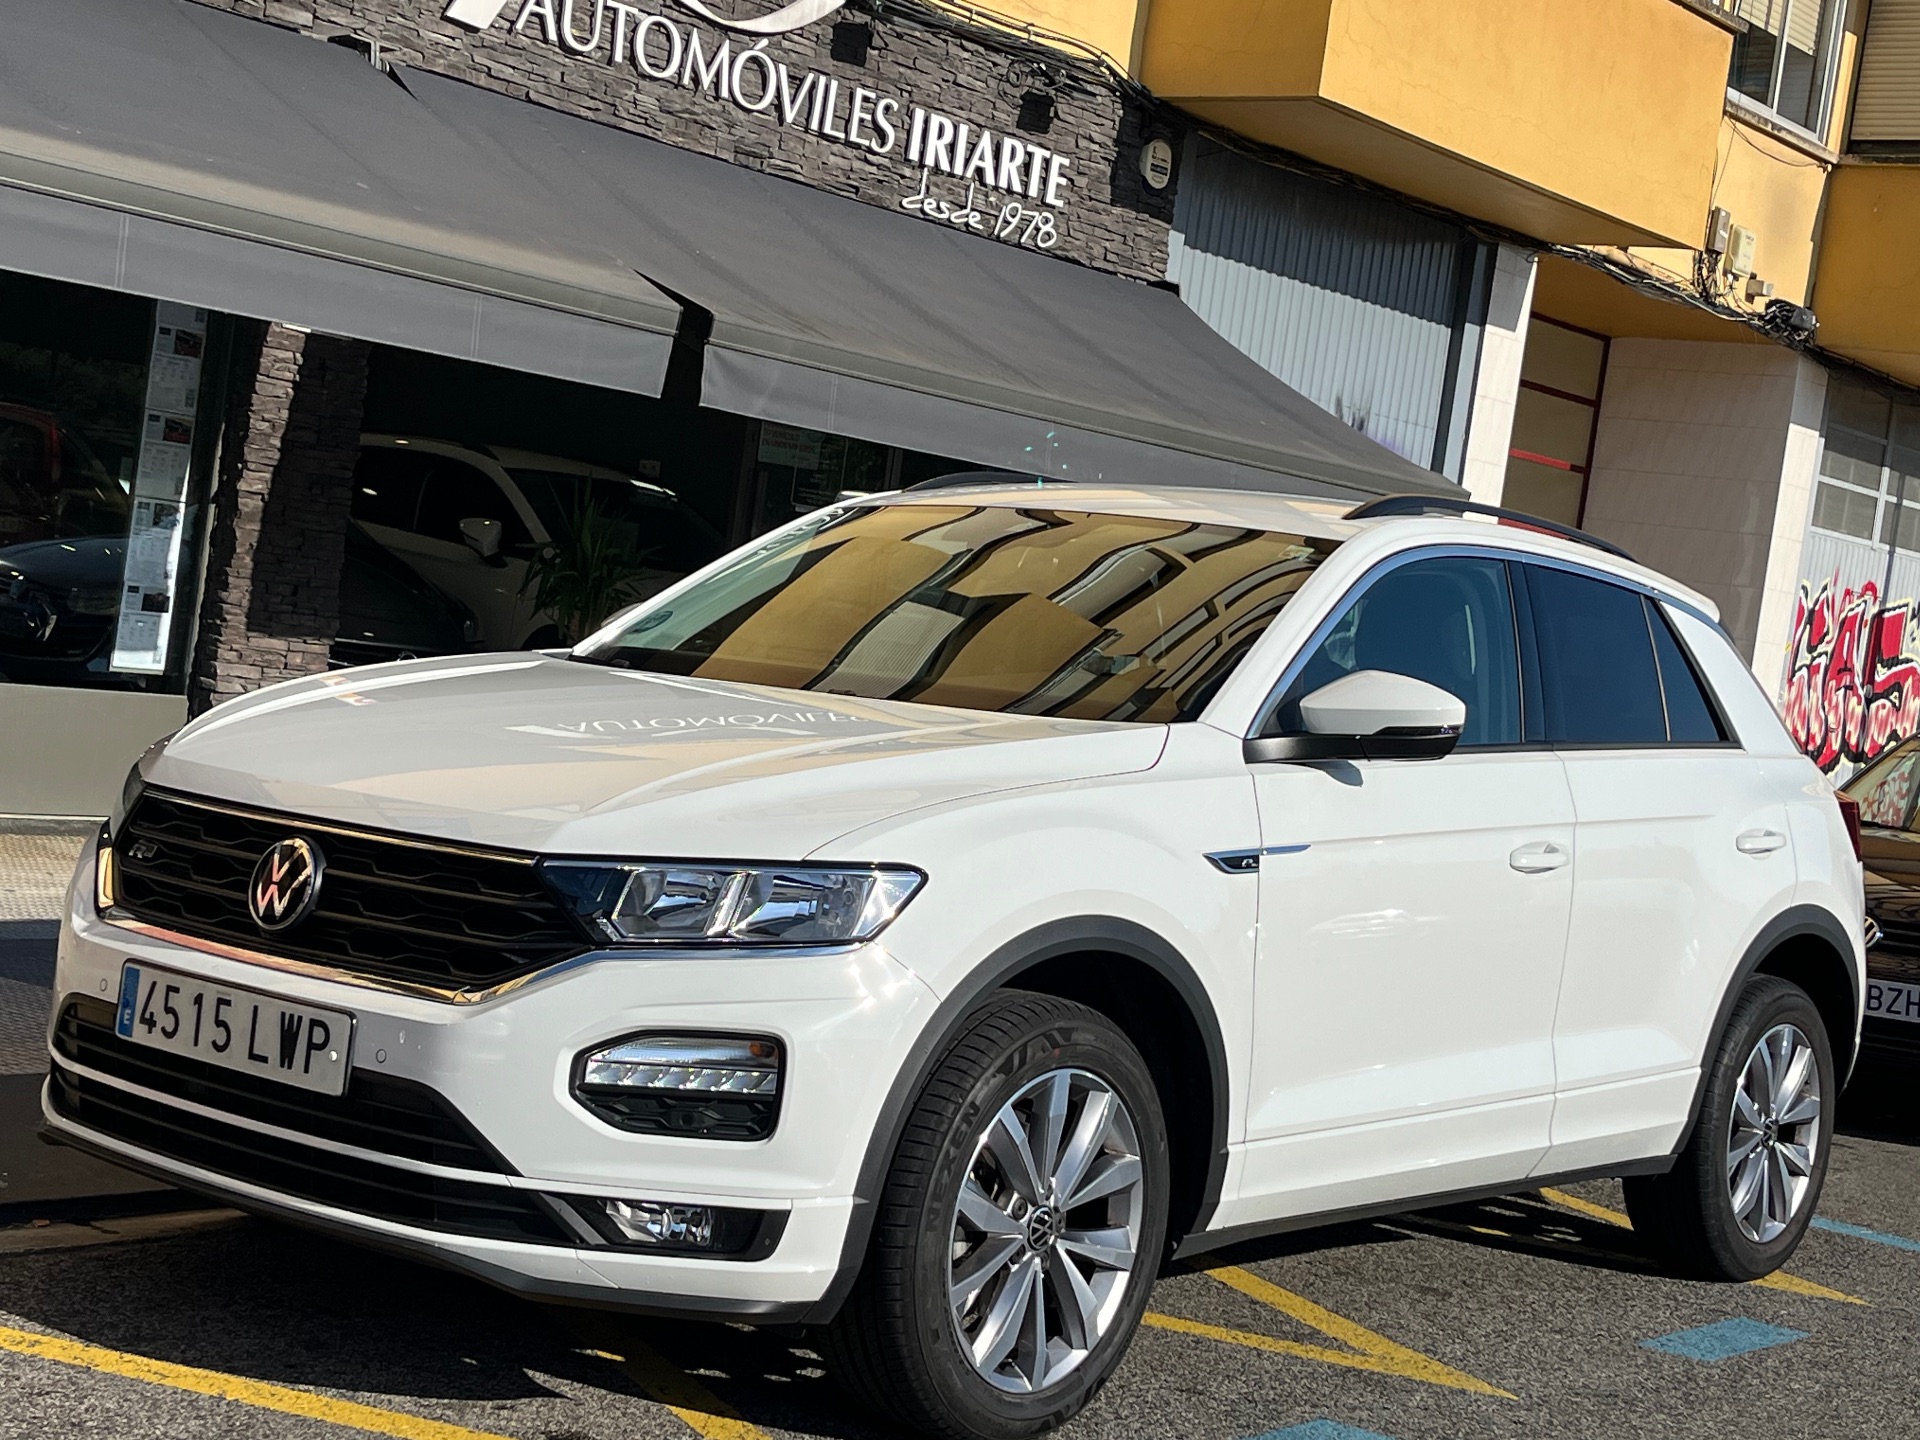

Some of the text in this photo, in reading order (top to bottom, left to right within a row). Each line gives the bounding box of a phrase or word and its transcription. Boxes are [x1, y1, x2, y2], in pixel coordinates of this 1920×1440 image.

[515, 0, 1070, 208] AUTOMÓVILES IRIARTE
[902, 167, 1057, 248] desde 1978
[138, 980, 331, 1074] 4515 LWP
[1867, 984, 1920, 1018] BZH
[926, 1099, 980, 1233] NEXEN
